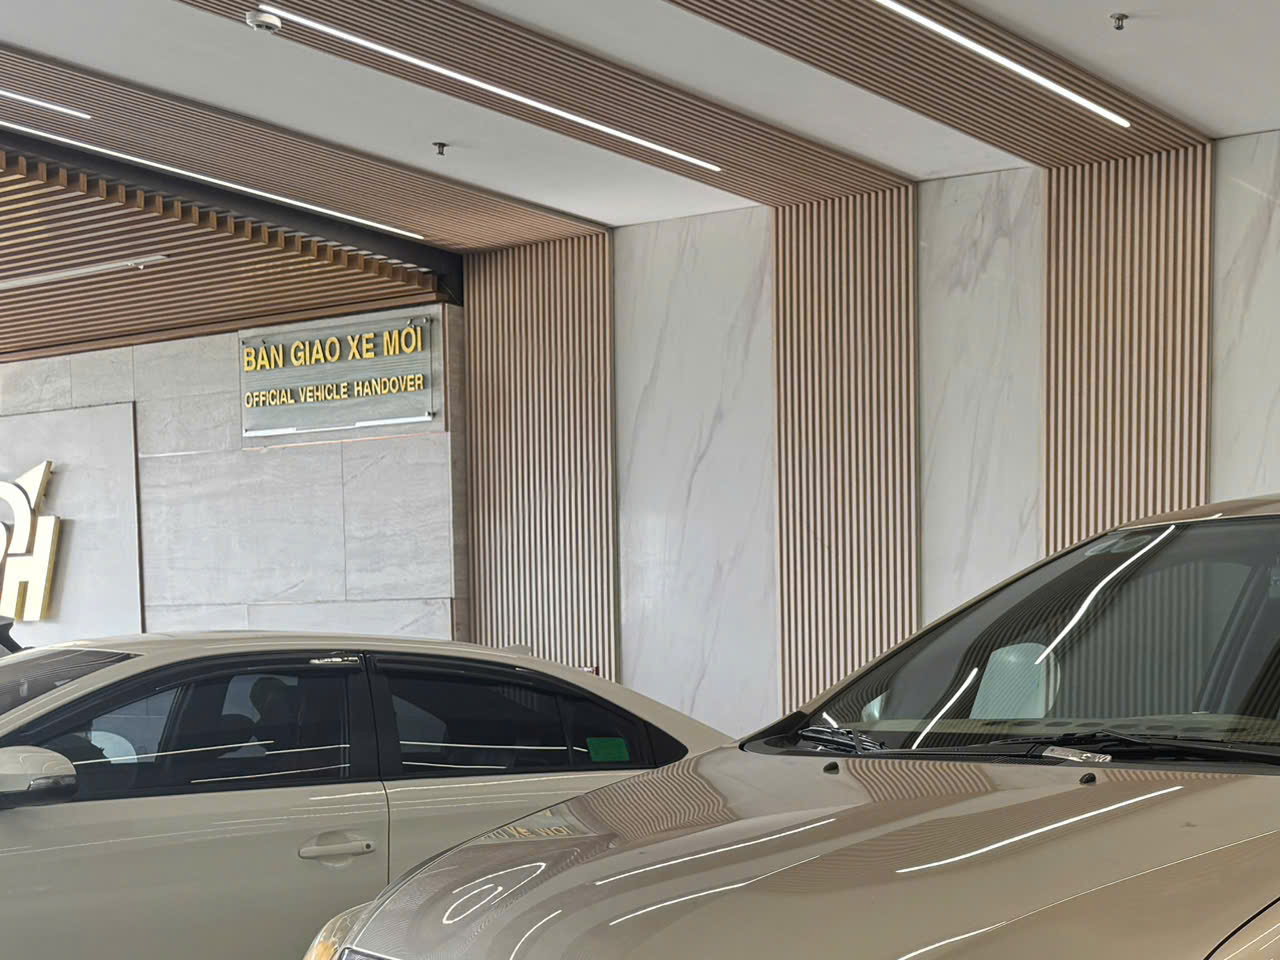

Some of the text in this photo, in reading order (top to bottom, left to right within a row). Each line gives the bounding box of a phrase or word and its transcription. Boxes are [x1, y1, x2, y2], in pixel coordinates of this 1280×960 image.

[289, 336, 341, 367] GIAO
[347, 332, 376, 361] XE
[244, 373, 425, 409] OFFICIAL VEHICLE HANDOVER
